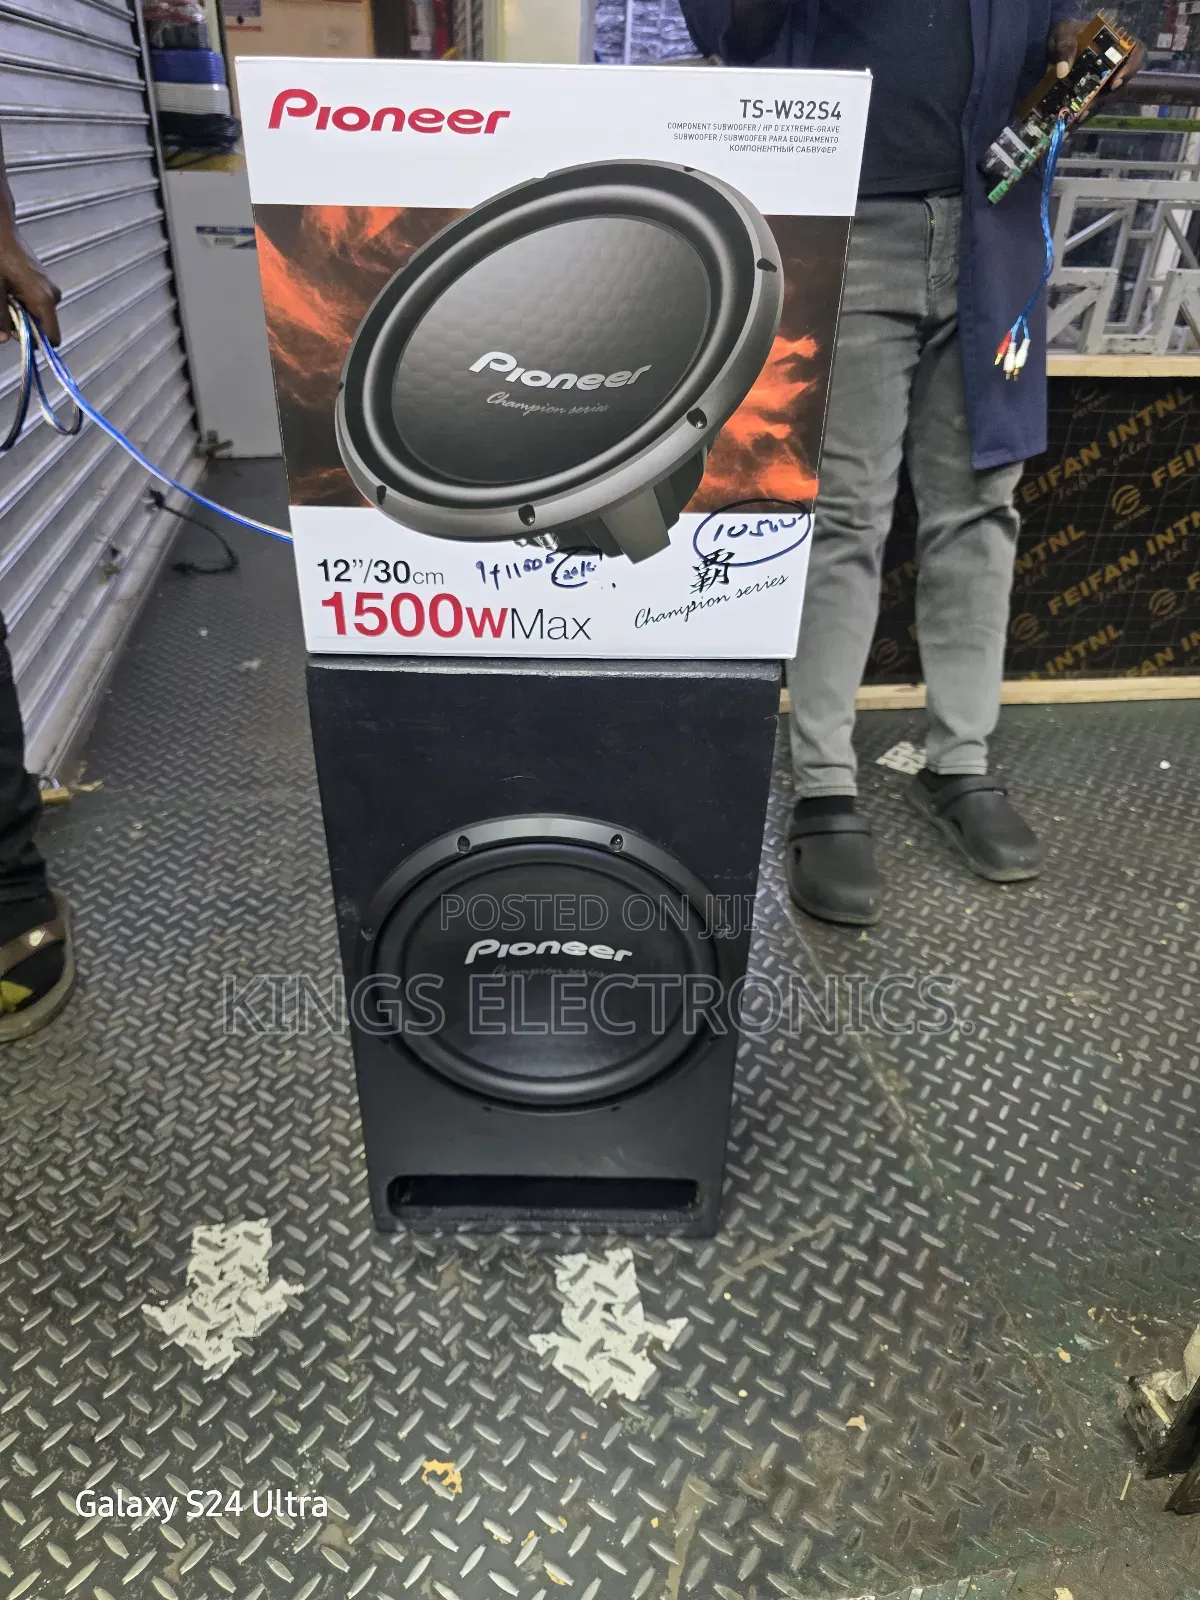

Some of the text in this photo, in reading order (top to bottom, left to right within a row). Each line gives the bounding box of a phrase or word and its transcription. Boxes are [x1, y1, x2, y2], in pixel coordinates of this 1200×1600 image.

[268, 88, 511, 135] Pioneer
[667, 122, 712, 131] COMPONENT
[713, 123, 757, 132] SUBWOOFER
[763, 124, 773, 132] HP
[739, 99, 842, 121] TS-W32S4
[674, 133, 718, 141] SUBWOOFER
[723, 134, 768, 143] SUBWOOFER
[768, 135, 788, 143] PARA
[789, 136, 839, 144] EQUIPAMENTO
[729, 144, 837, 154] КОМПОНЕНТНЫЙ САБВУФЕР
[468, 351, 653, 391] Pioneer
[486, 391, 611, 417] Champion series
[1107, 387, 1194, 448] INTNL
[1013, 524, 1086, 575] NTNL
[634, 575, 789, 629] Champion series
[1049, 550, 1140, 616] FEIFAN
[1045, 624, 1124, 676] INTNL
[464, 938, 633, 966] Pioneer
